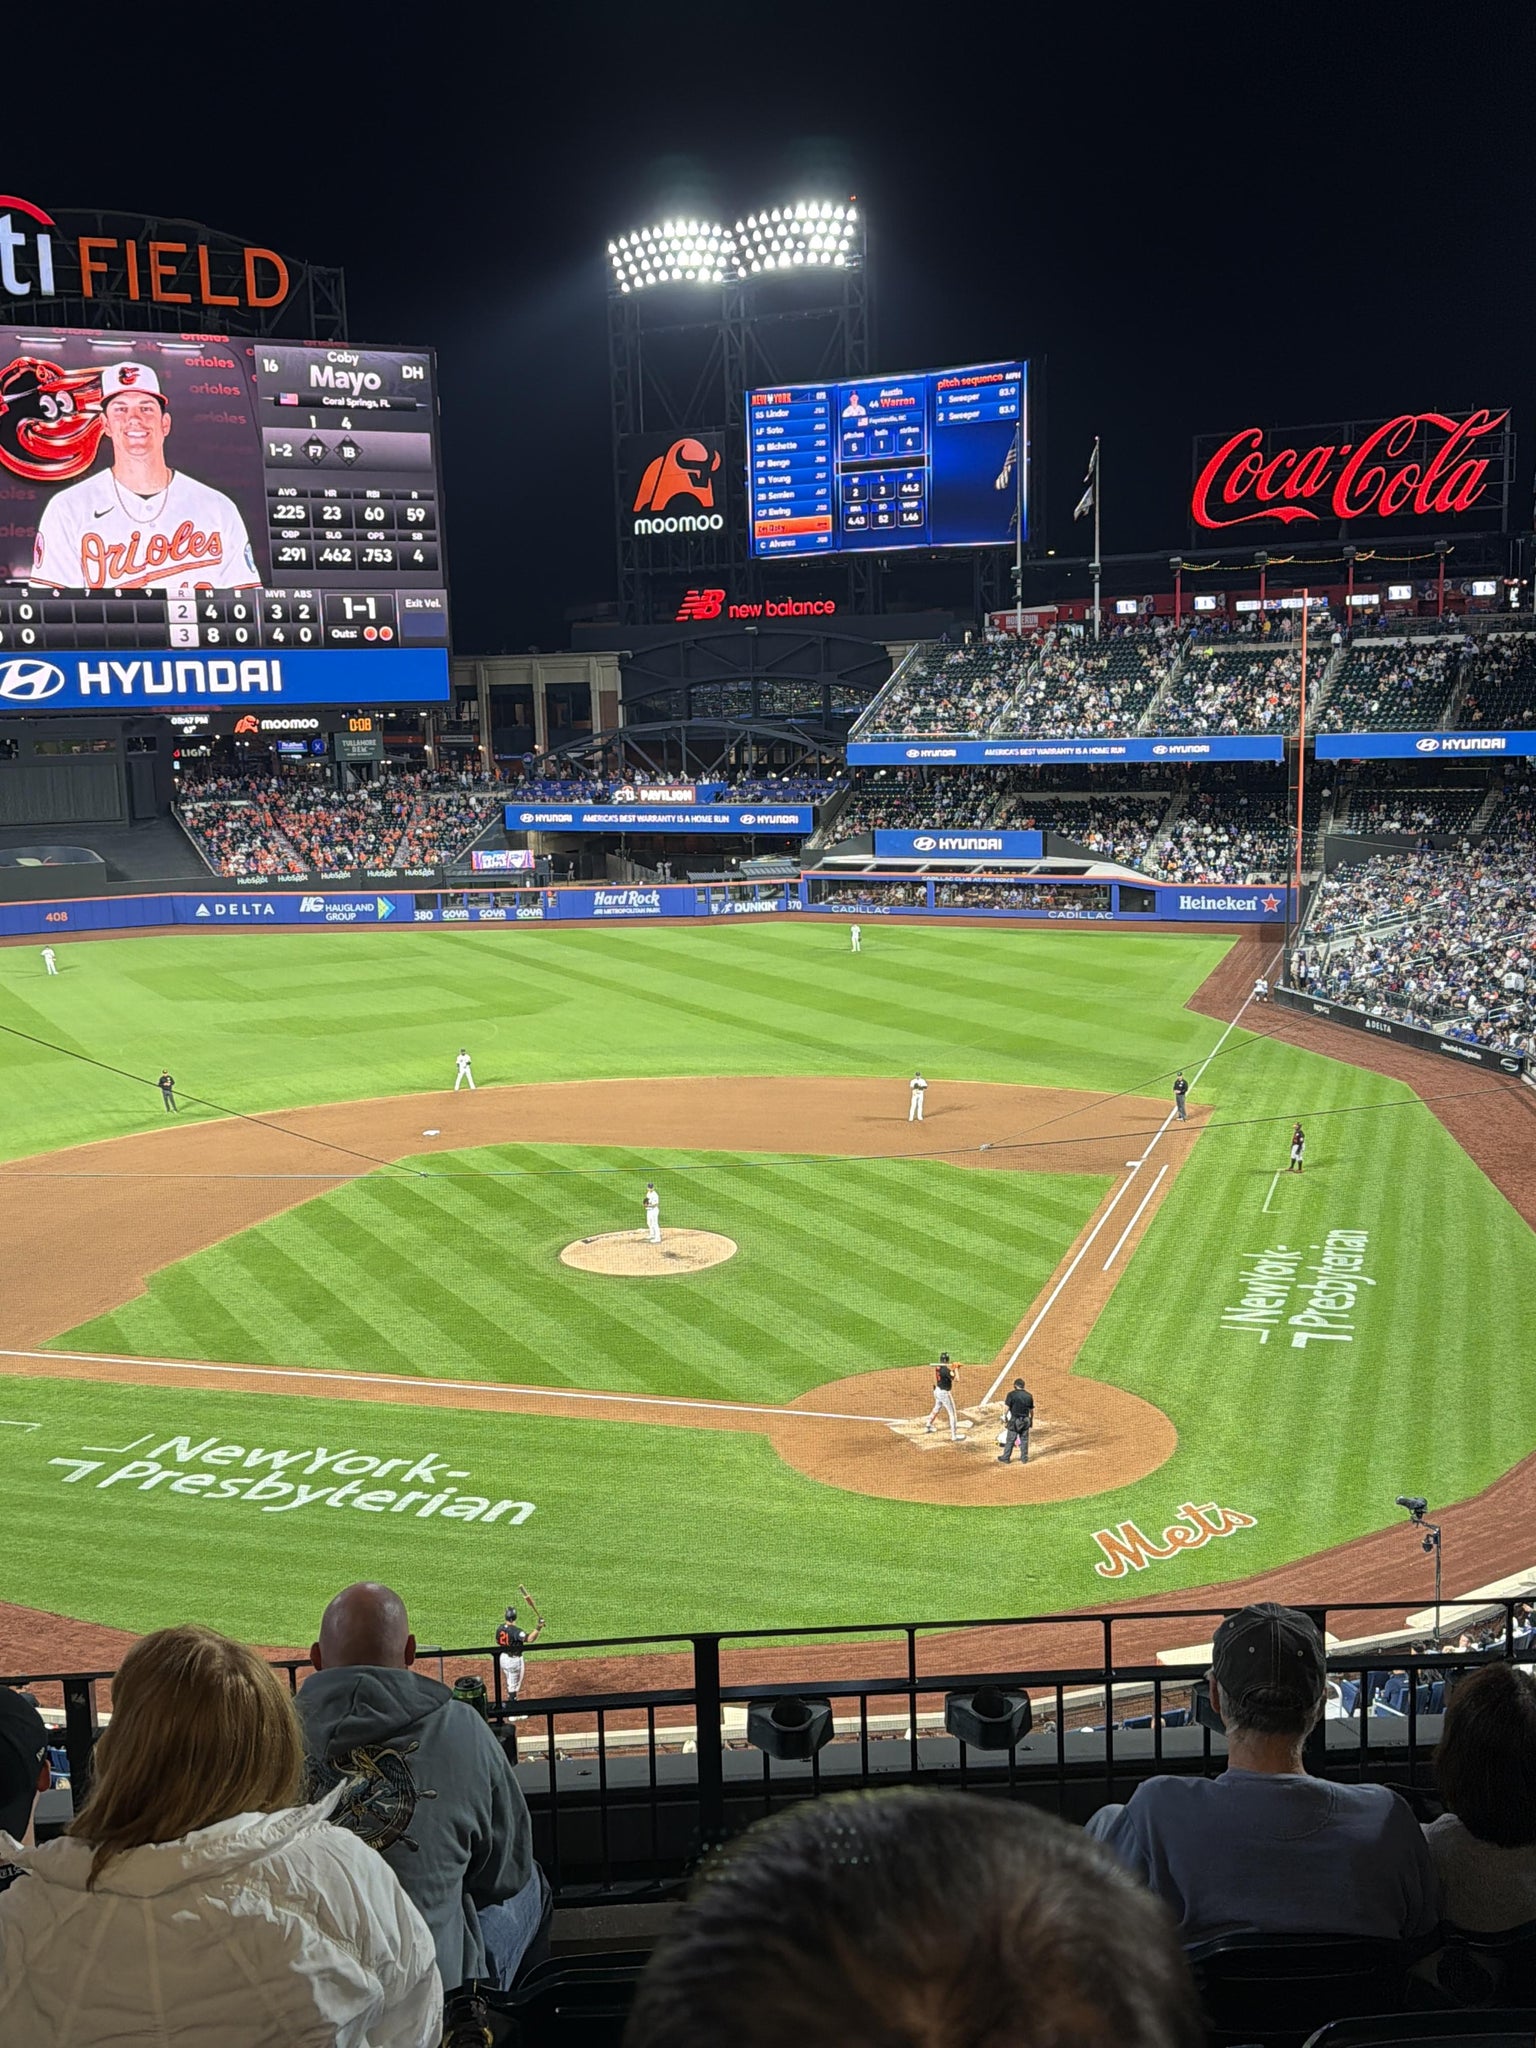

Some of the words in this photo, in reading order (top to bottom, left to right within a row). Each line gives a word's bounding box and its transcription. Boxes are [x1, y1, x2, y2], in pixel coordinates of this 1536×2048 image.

[79, 237, 290, 307] FIELD
[185, 355, 235, 369] orioles
[327, 351, 359, 366] Coby
[263, 359, 279, 372] 16
[310, 365, 381, 396] Mayo
[402, 366, 424, 380] DH
[938, 378, 960, 390] pitch
[961, 374, 1003, 387] sequence
[1005, 372, 1021, 380] MPH
[190, 382, 241, 396] orioles
[880, 388, 903, 397] Austin
[322, 397, 345, 406] Coral
[379, 399, 391, 408] FL
[774, 393, 791, 403] YORK
[869, 400, 879, 408] 44
[880, 397, 915, 408] Warren
[938, 396, 942, 404] 1
[949, 394, 980, 403] Sweeper
[755, 411, 764, 419] SS
[766, 408, 789, 418] Lindor
[938, 413, 944, 421] 2
[949, 411, 980, 421] Sweeper
[310, 415, 317, 428] 1
[341, 417, 352, 429] 4
[767, 426, 784, 435] Soto
[767, 442, 797, 451] Bichette
[852, 443, 857, 452] 5
[906, 438, 913, 446] 4
[269, 443, 293, 458] 1-2
[309, 445, 322, 458] F7
[1192, 407, 1512, 529] Coca-Cola
[768, 476, 791, 485] Young
[278, 488, 297, 496] AVG
[324, 489, 337, 498] HR
[366, 491, 380, 499] RBI
[411, 491, 418, 499] R
[768, 491, 795, 500] Semien
[853, 489, 859, 497] 2
[880, 487, 885, 495] 3
[273, 505, 305, 519] .225
[322, 506, 341, 520] 23
[364, 507, 384, 521] 60
[406, 508, 425, 522] 59
[769, 507, 791, 517] Ewing
[634, 514, 723, 535] moomoo
[281, 531, 300, 539] OBP
[325, 532, 342, 540] SLG
[367, 532, 385, 540] OPS
[412, 533, 423, 541] SB
[769, 539, 796, 548] Alvarez
[80, 521, 223, 588] Orioles
[278, 547, 306, 562] .291
[319, 548, 352, 562] .462
[362, 549, 393, 563] .753
[413, 549, 424, 563] 4
[21, 589, 29, 598] 5
[52, 589, 60, 598] 6
[85, 589, 91, 598] 7
[115, 589, 122, 598] 8
[145, 589, 153, 598] 9
[178, 589, 186, 598] R
[205, 589, 214, 598] H
[234, 589, 242, 598] E
[265, 590, 286, 599] MVR
[294, 590, 312, 599] ABS
[19, 604, 33, 620] 0
[178, 604, 188, 619] 2
[205, 604, 218, 619] 4
[234, 604, 247, 620] 0
[271, 604, 282, 620] 3
[299, 604, 310, 620] 2
[343, 597, 376, 620] 1-1
[405, 599, 423, 608] Exit
[424, 599, 441, 608] Vel.
[729, 604, 762, 618] new
[766, 598, 835, 617] balance
[21, 628, 35, 645] 0
[180, 628, 190, 643] 3
[207, 627, 220, 643] 8
[235, 627, 248, 643] 0
[272, 628, 285, 643] 4
[300, 627, 312, 643] 0
[331, 629, 357, 639] Outs:
[79, 660, 282, 694] HYUNDAI
[195, 716, 209, 725] PM
[261, 718, 319, 730] moomoo
[342, 739, 376, 747] TULLAMORE
[1442, 737, 1506, 750] HYUNDAI
[921, 749, 956, 758] HYUNDAI
[985, 748, 1019, 756] AMERICA'S
[1020, 748, 1036, 756] BEST
[1037, 747, 1074, 756] WARRANTY
[1089, 747, 1110, 755] HOME
[1111, 746, 1126, 754] RUN
[1169, 745, 1210, 754] HYUNDAI
[641, 789, 693, 801] PAVILION
[535, 814, 572, 823] HYUNDAI
[583, 814, 619, 823] AMERICA'S
[619, 814, 636, 823] BEST
[637, 815, 675, 823] WARRANTY
[677, 815, 684, 823] IS
[684, 815, 690, 823] A
[691, 815, 712, 823] HOME
[713, 815, 730, 823] RUN
[757, 815, 799, 824] HYUNDAI
[939, 837, 1003, 851] HYUNDAI
[278, 873, 309, 882] HubSpot
[321, 870, 351, 880] HubSpot
[367, 869, 397, 878] HubSpot
[404, 868, 435, 878] HubSpot
[237, 876, 268, 885] HubSpot
[594, 891, 627, 906] Hard
[628, 890, 660, 907] Rock
[1179, 895, 1257, 912] Heineken
[215, 902, 275, 917] DELTA
[326, 903, 375, 913] HAUGLAND
[603, 907, 645, 915] METROPOLITAN
[787, 901, 803, 911] 370
[831, 905, 890, 915] CADILLAC
[46, 912, 68, 923] 408
[326, 912, 357, 921] GROUP
[414, 910, 434, 921] 380
[442, 909, 469, 919] GOYA
[479, 908, 506, 918] GOYA
[516, 908, 543, 917] GOYA
[1048, 910, 1114, 920] CADILLAC
[1371, 1021, 1392, 1034] DELTA
[1288, 1230, 1377, 1329] Presbyterian
[97, 1460, 536, 1525] Presbyterian
[1090, 1502, 1258, 1578] Mets
[499, 1630, 510, 1646] 21
